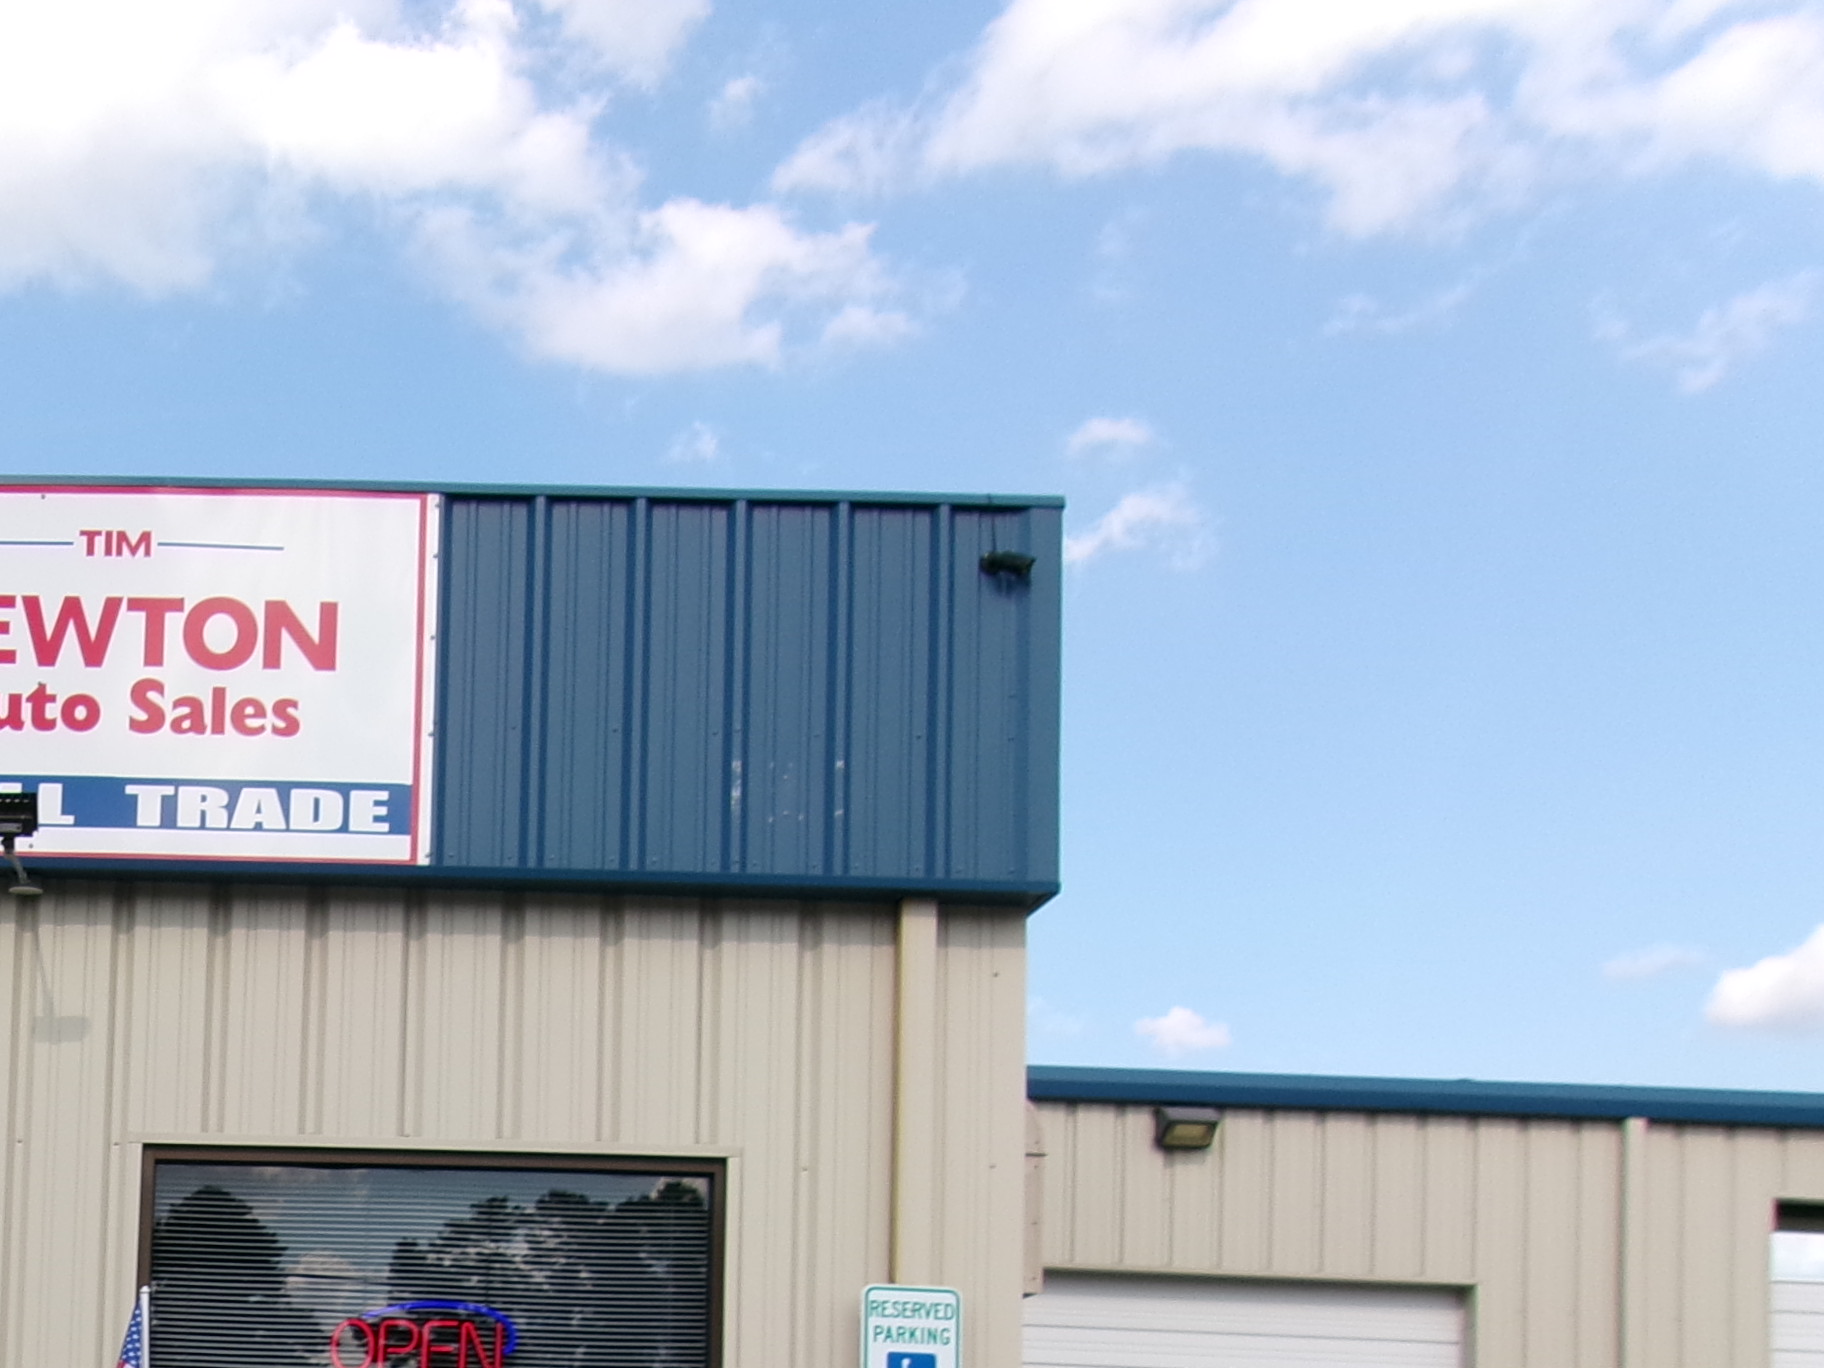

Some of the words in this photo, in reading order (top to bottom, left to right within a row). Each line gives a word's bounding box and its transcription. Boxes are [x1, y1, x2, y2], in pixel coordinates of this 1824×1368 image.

[79, 530, 153, 559] TIM
[129, 678, 302, 738] Sales
[124, 784, 390, 833] TRADE
[868, 1299, 955, 1321] RESERVED
[873, 1325, 951, 1346] PARKING
